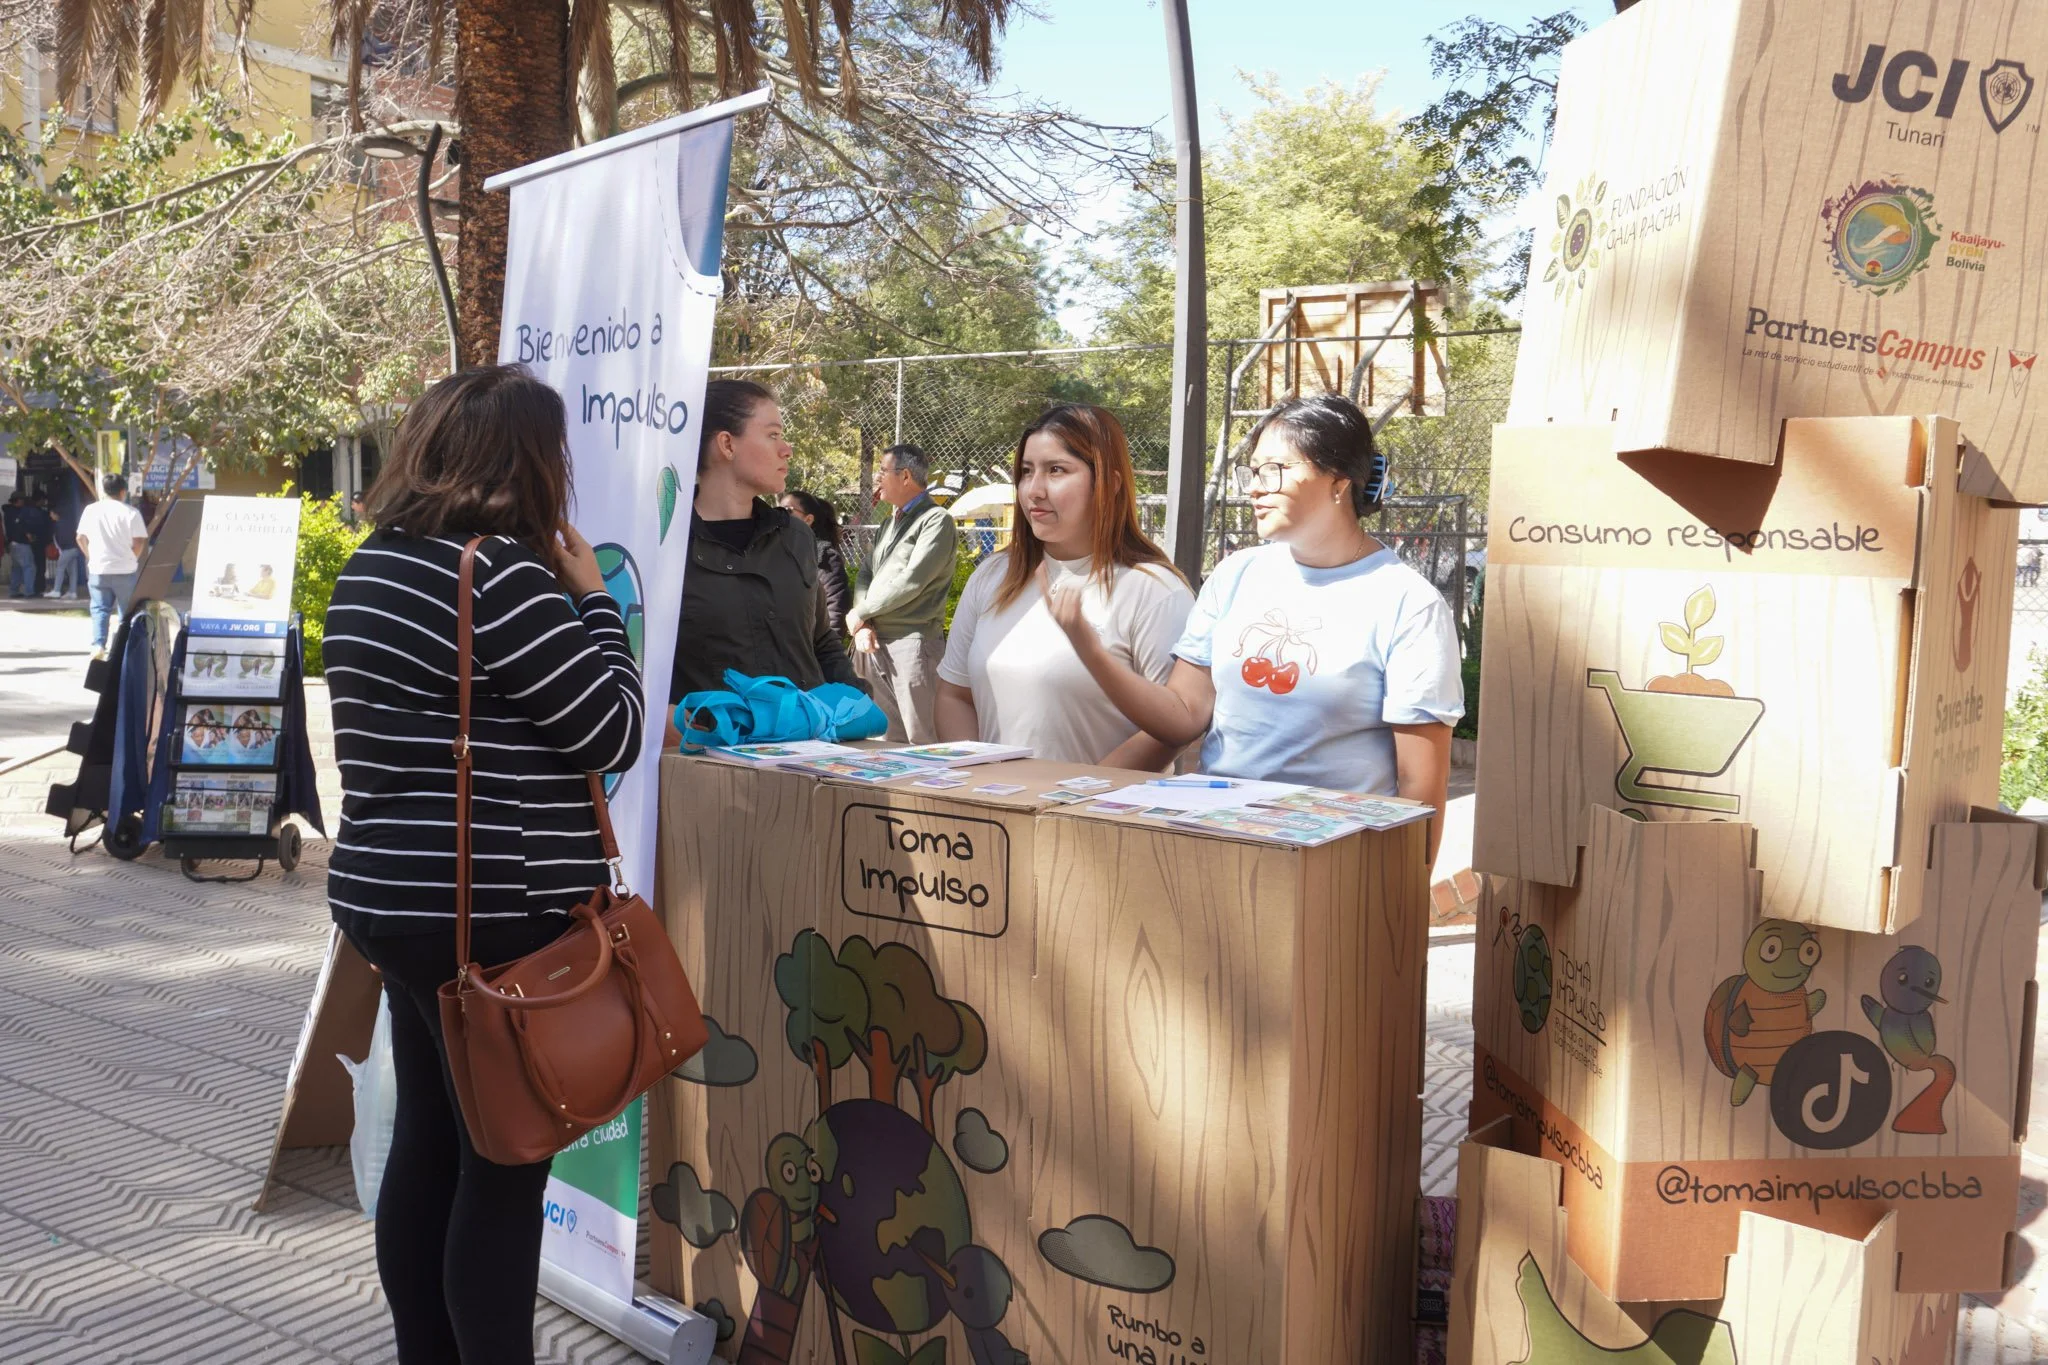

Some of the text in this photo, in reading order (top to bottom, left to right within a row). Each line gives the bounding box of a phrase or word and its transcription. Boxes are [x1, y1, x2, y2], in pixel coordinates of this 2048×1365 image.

[1832, 44, 1970, 119] JCI
[1887, 121, 1945, 148] Tunari
[1611, 165, 1689, 220] FUNDACIÓN
[1640, 202, 1681, 238] PACHA
[1945, 257, 1986, 272] Bolivia
[516, 307, 662, 363] Bienvenido a
[1745, 307, 1986, 371] PartnersCampus
[1743, 347, 1874, 374] La red de servicio estudiantil de
[582, 383, 688, 450] Impulso
[1508, 516, 1884, 562] Consumo responsable
[200, 622, 220, 630] VAYA
[229, 623, 260, 631] JW.ORG
[1934, 694, 1961, 736] Save
[875, 814, 974, 860] Toma
[859, 858, 989, 914] Impulso
[1559, 949, 1592, 992] TOMA
[1556, 978, 1606, 1031] IMPULSO
[593, 1113, 629, 1144] ciudad
[1656, 1165, 1982, 1215] @tomaimpulsocbba
[1107, 1304, 1206, 1355] Rumbo a
[1107, 1334, 1157, 1365] una
